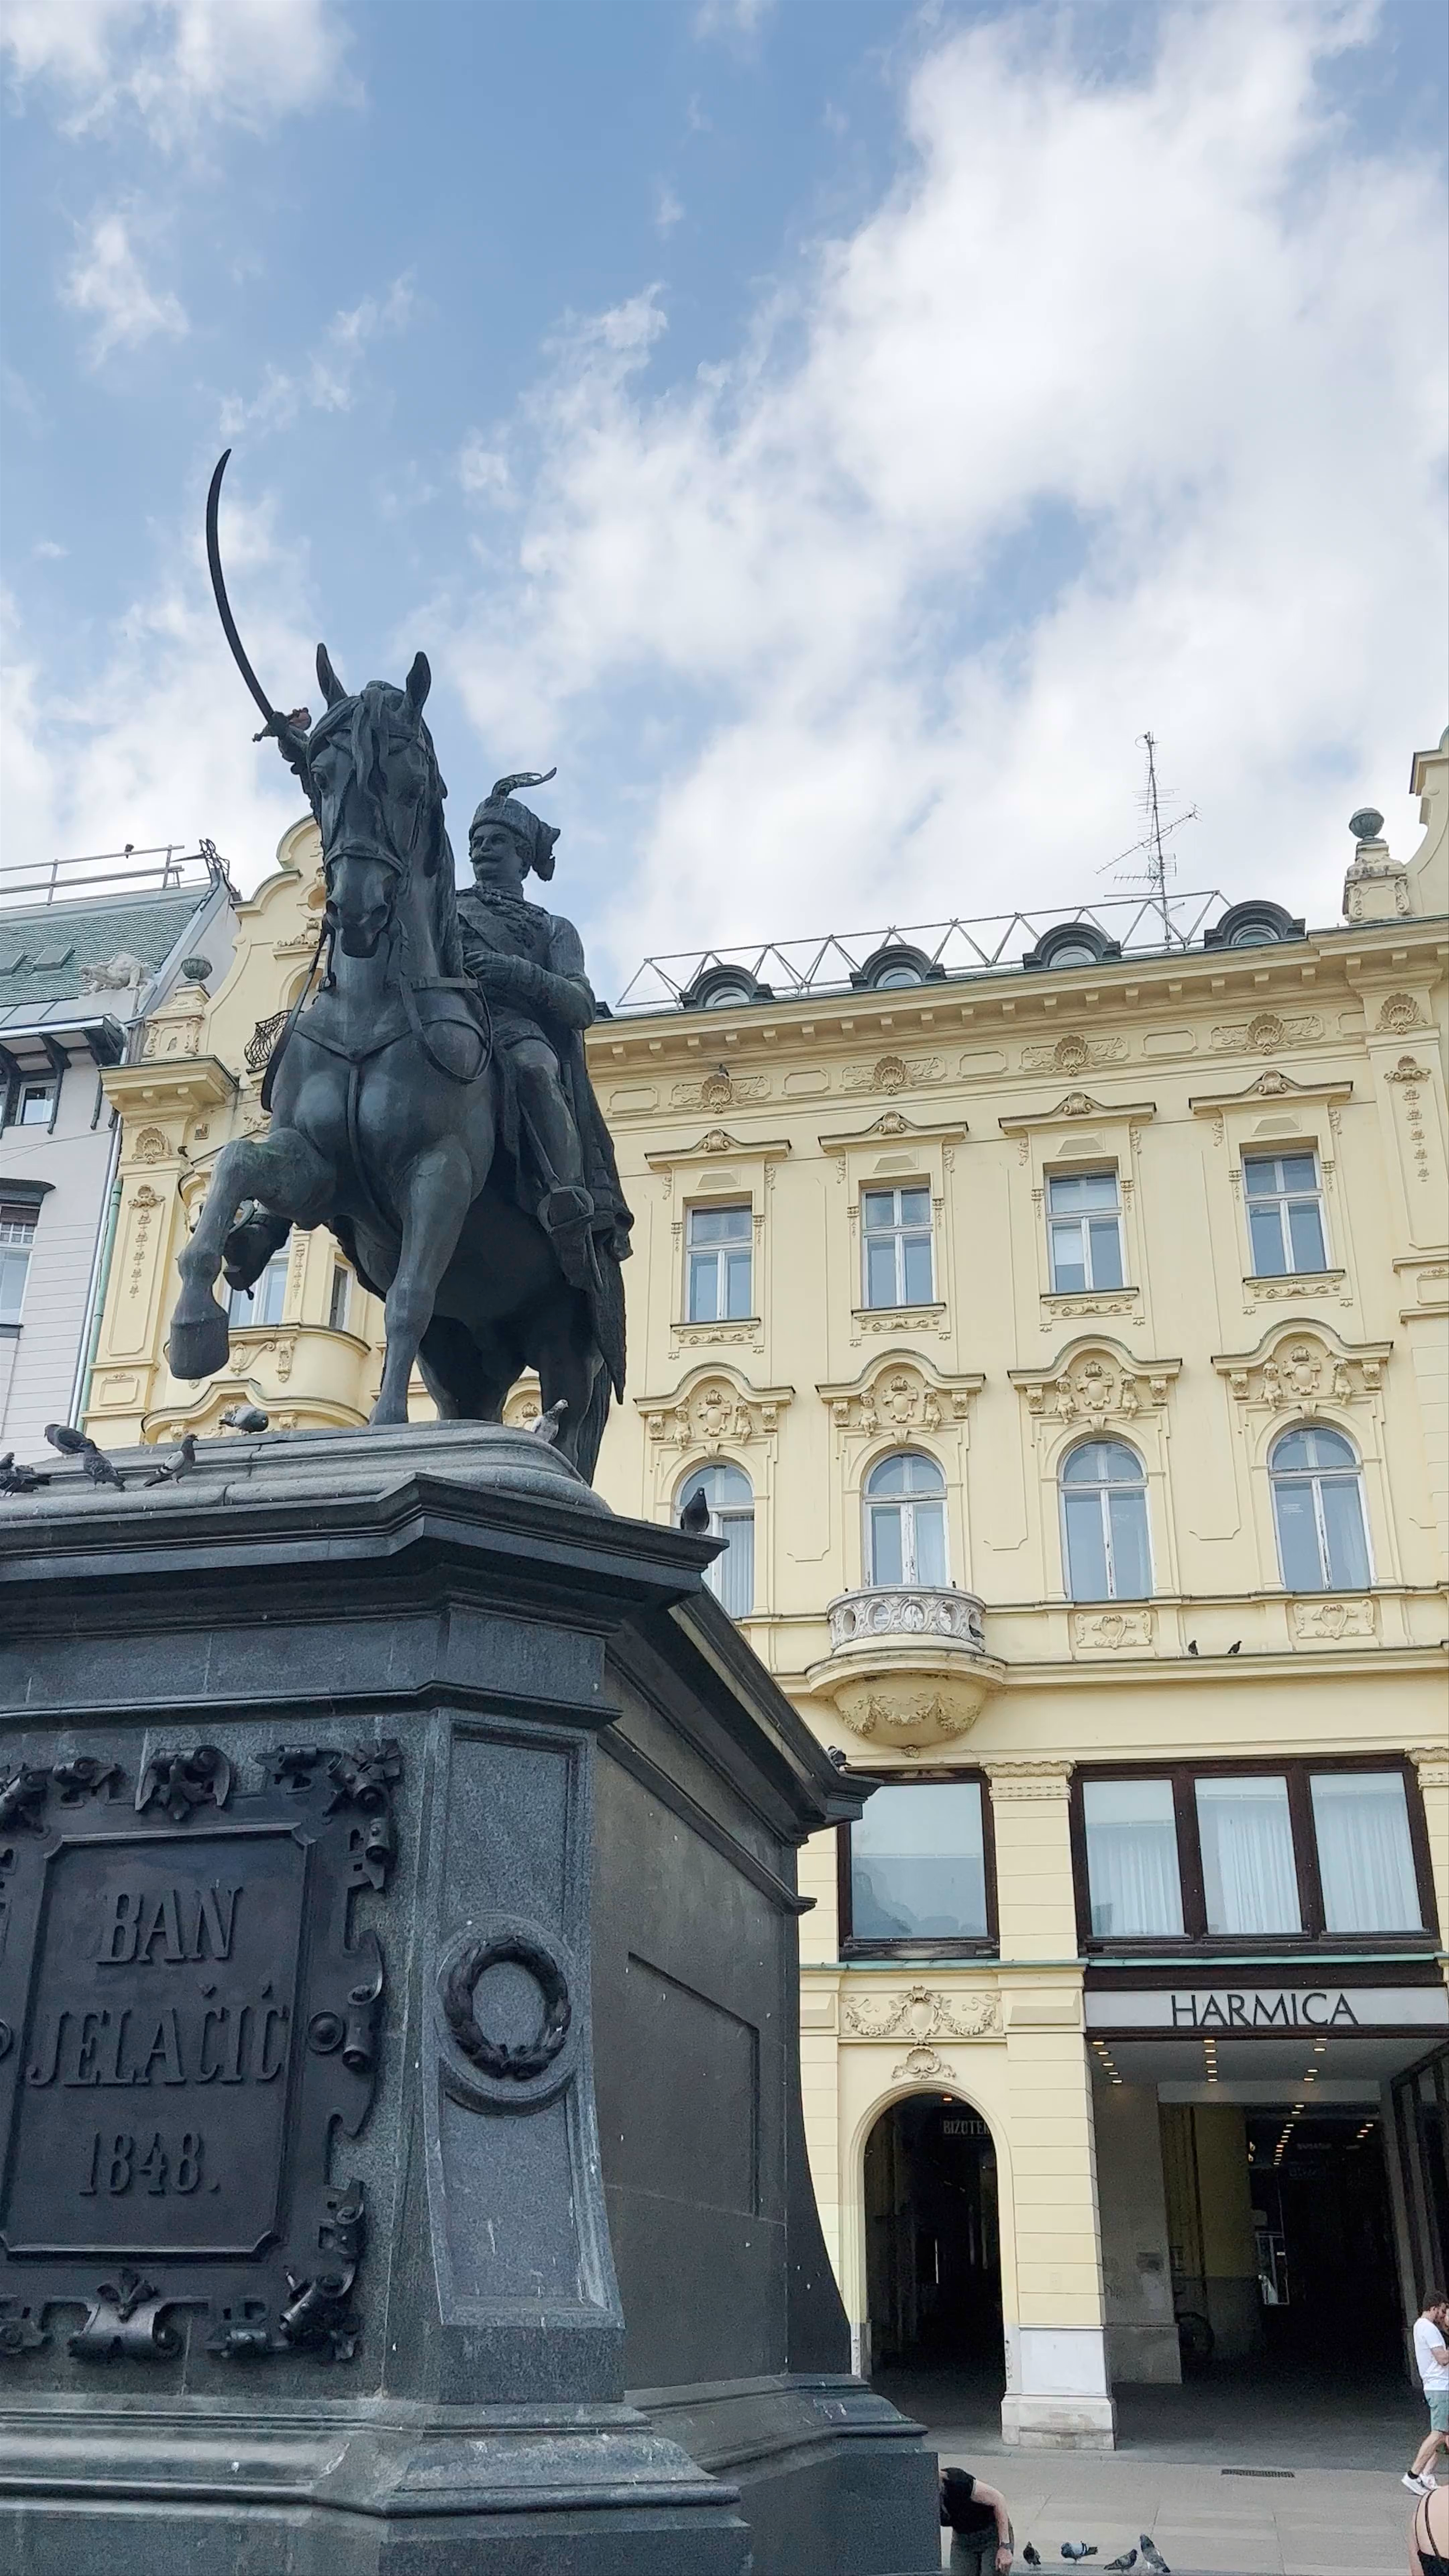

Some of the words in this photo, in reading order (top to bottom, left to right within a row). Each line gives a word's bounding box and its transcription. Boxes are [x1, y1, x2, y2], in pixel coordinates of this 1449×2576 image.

[96, 1887, 244, 1964] BAN
[26, 1982, 291, 2087] JELAČIĆ
[1171, 1993, 1358, 2026] HARMICA
